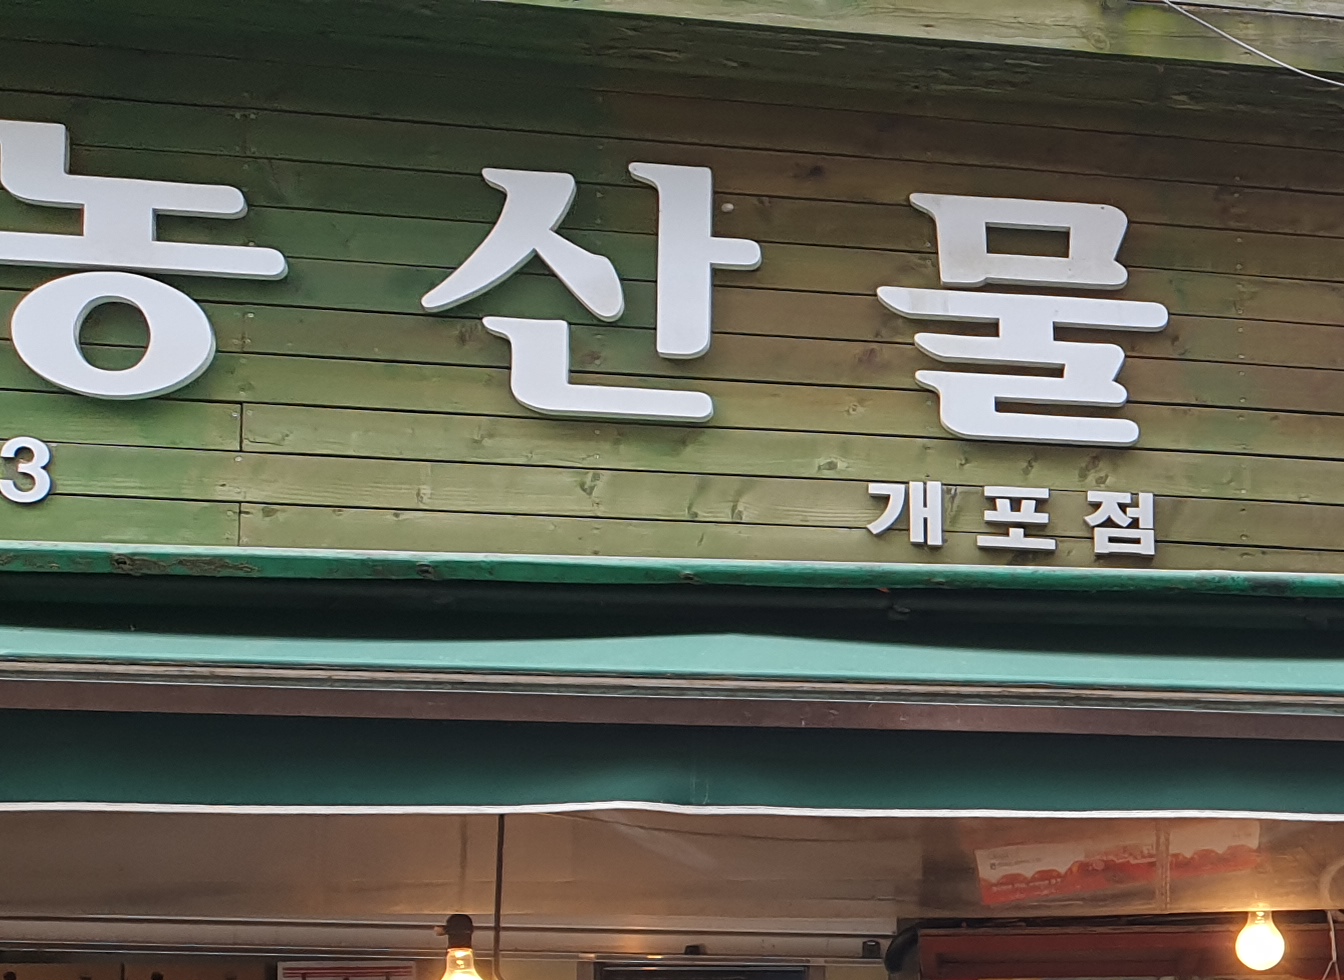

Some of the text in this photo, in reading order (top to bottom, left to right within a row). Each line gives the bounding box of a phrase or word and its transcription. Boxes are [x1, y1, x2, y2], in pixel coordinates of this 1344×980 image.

[0, 122, 1168, 447] 농산물
[0, 437, 53, 504] 3
[867, 481, 1157, 557] 개포점
